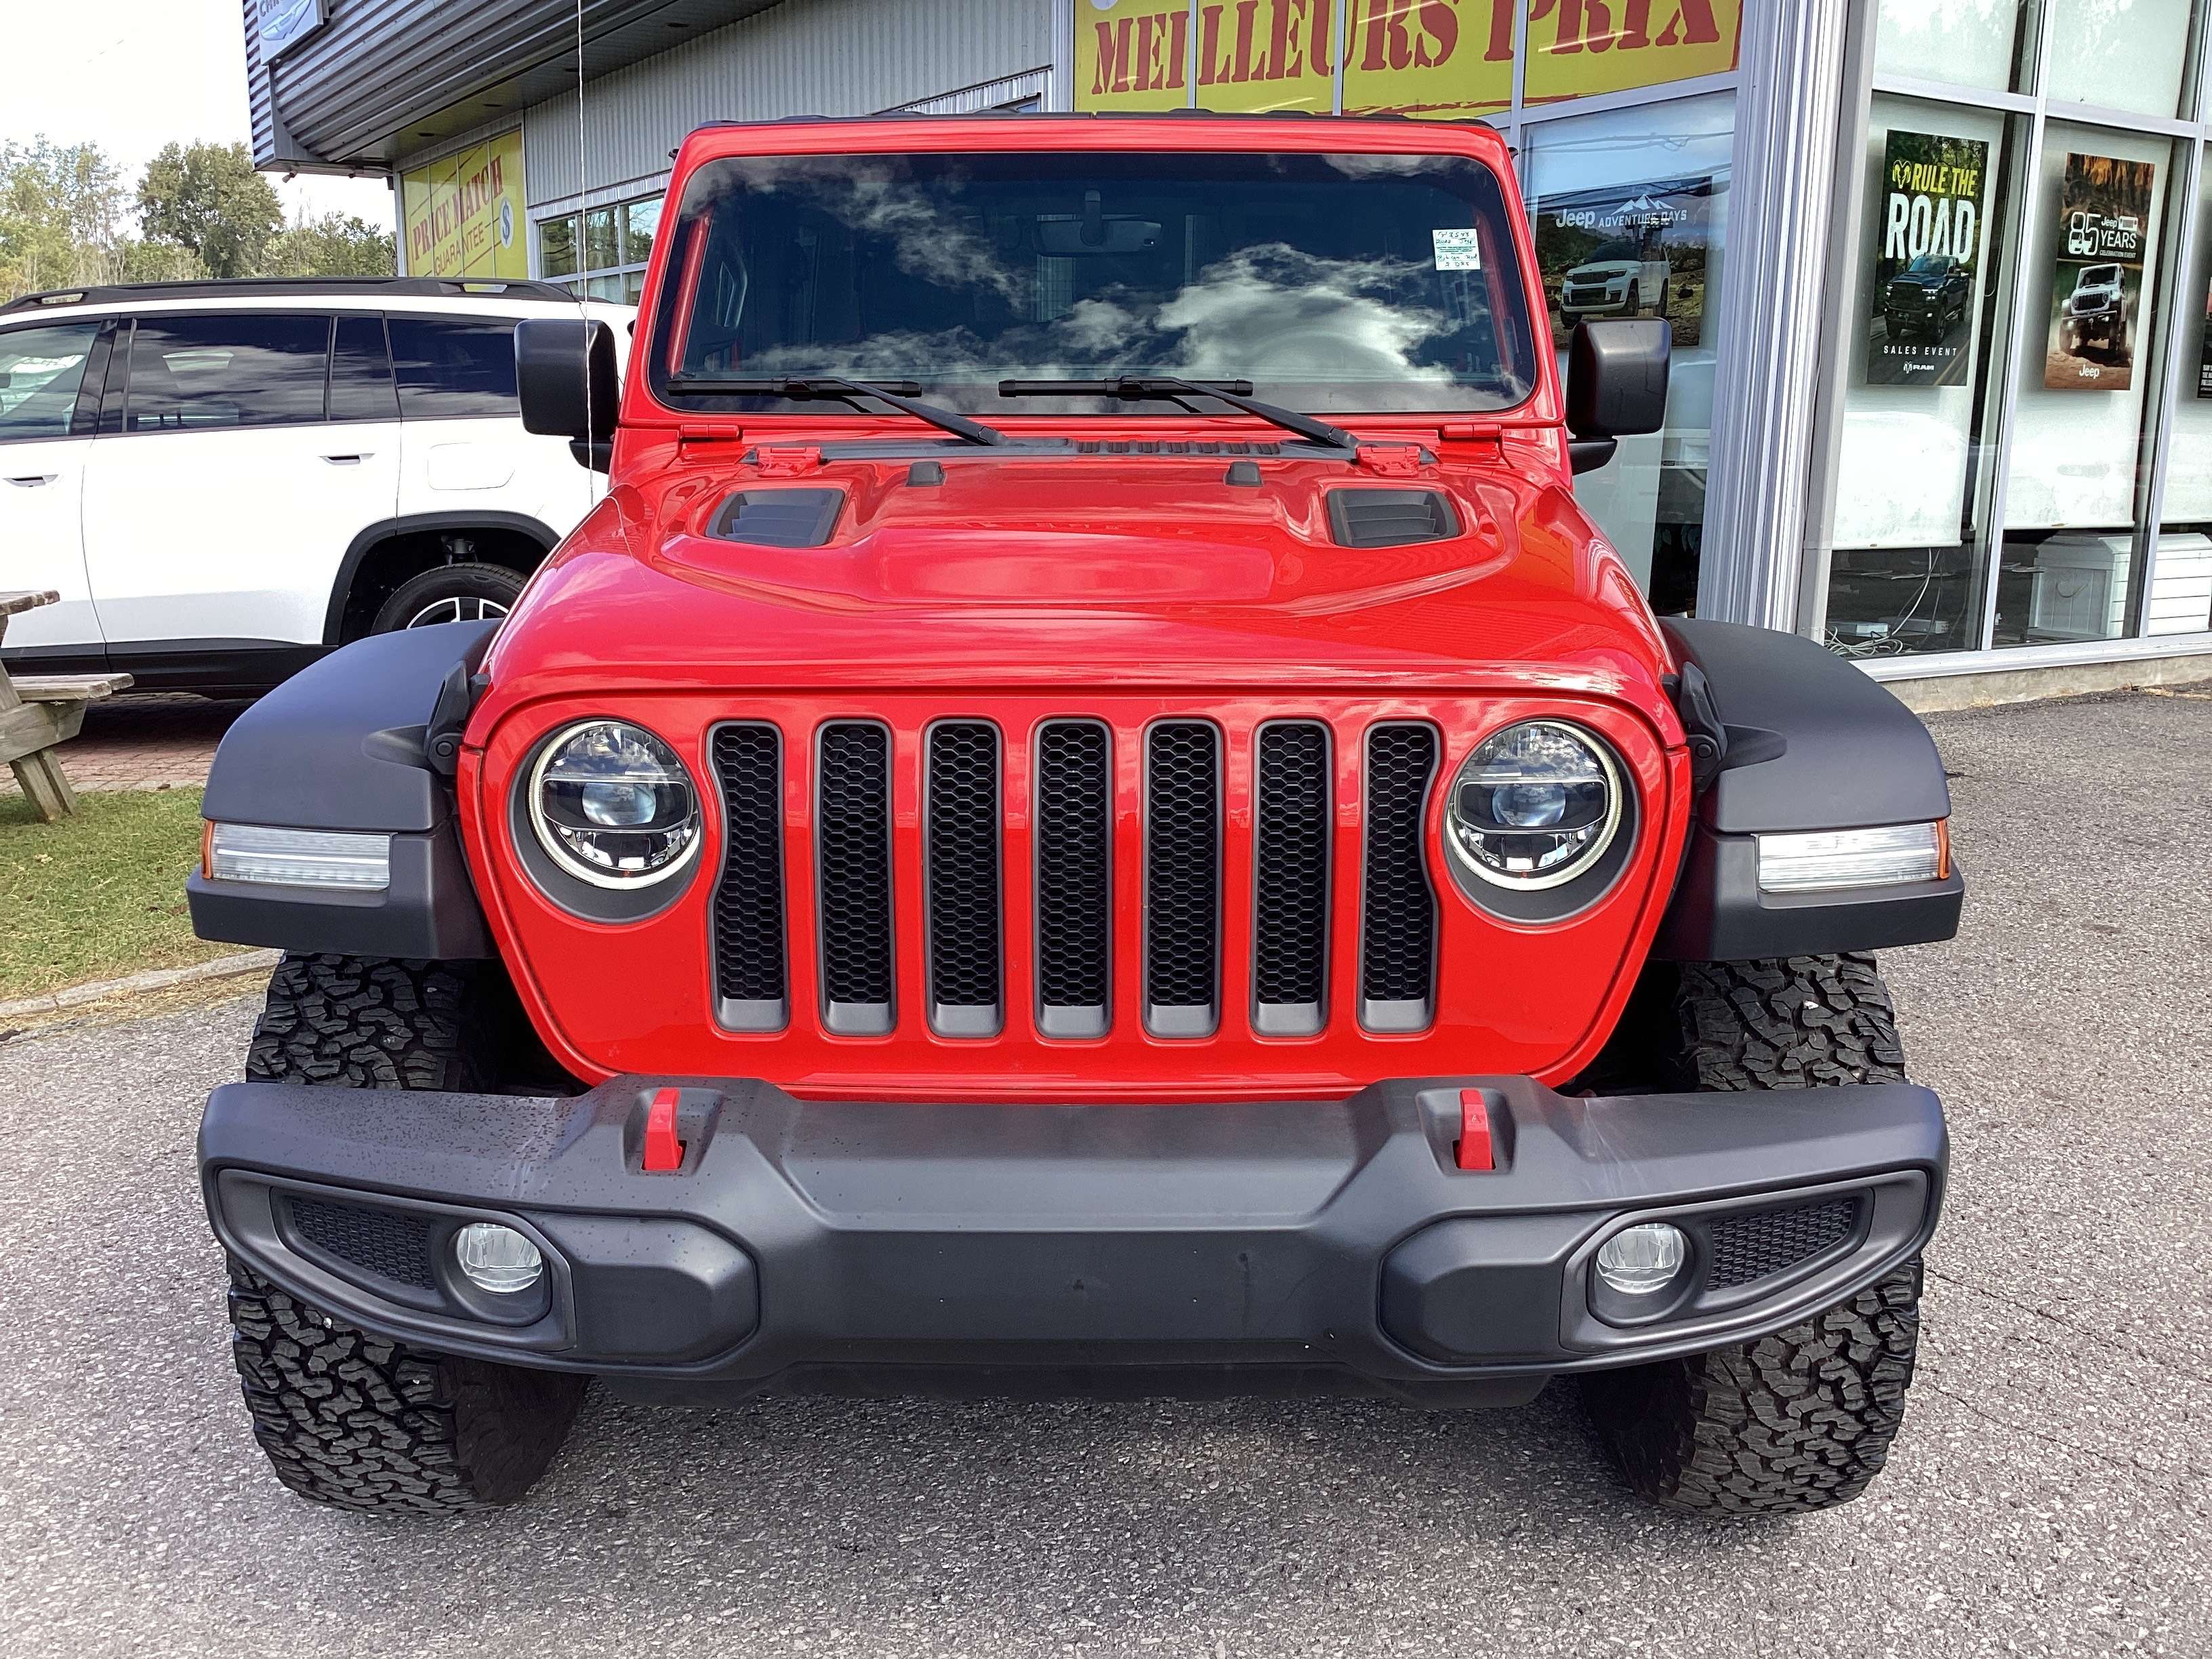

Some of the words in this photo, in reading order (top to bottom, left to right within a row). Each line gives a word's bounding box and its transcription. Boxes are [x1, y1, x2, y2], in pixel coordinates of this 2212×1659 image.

[1091, 0, 1458, 94] MEILLEURS
[1911, 163, 1948, 193] RULE
[1951, 167, 1978, 197] THE
[413, 199, 451, 260] PRICE
[452, 155, 504, 229] MATCH
[1556, 209, 1595, 228] Jeep
[1598, 213, 1658, 228] ADVENTURE
[1661, 209, 1687, 222] DAYS
[2101, 216, 2118, 229] Jeep
[1885, 192, 1975, 264] ROAD
[2068, 211, 2101, 255] 85
[2101, 230, 2137, 249] YEARS
[434, 221, 484, 276] GUARANTEE
[1883, 346, 1917, 354] SALES
[1924, 346, 1958, 356] EVENT
[2078, 363, 2100, 380] Jeep
